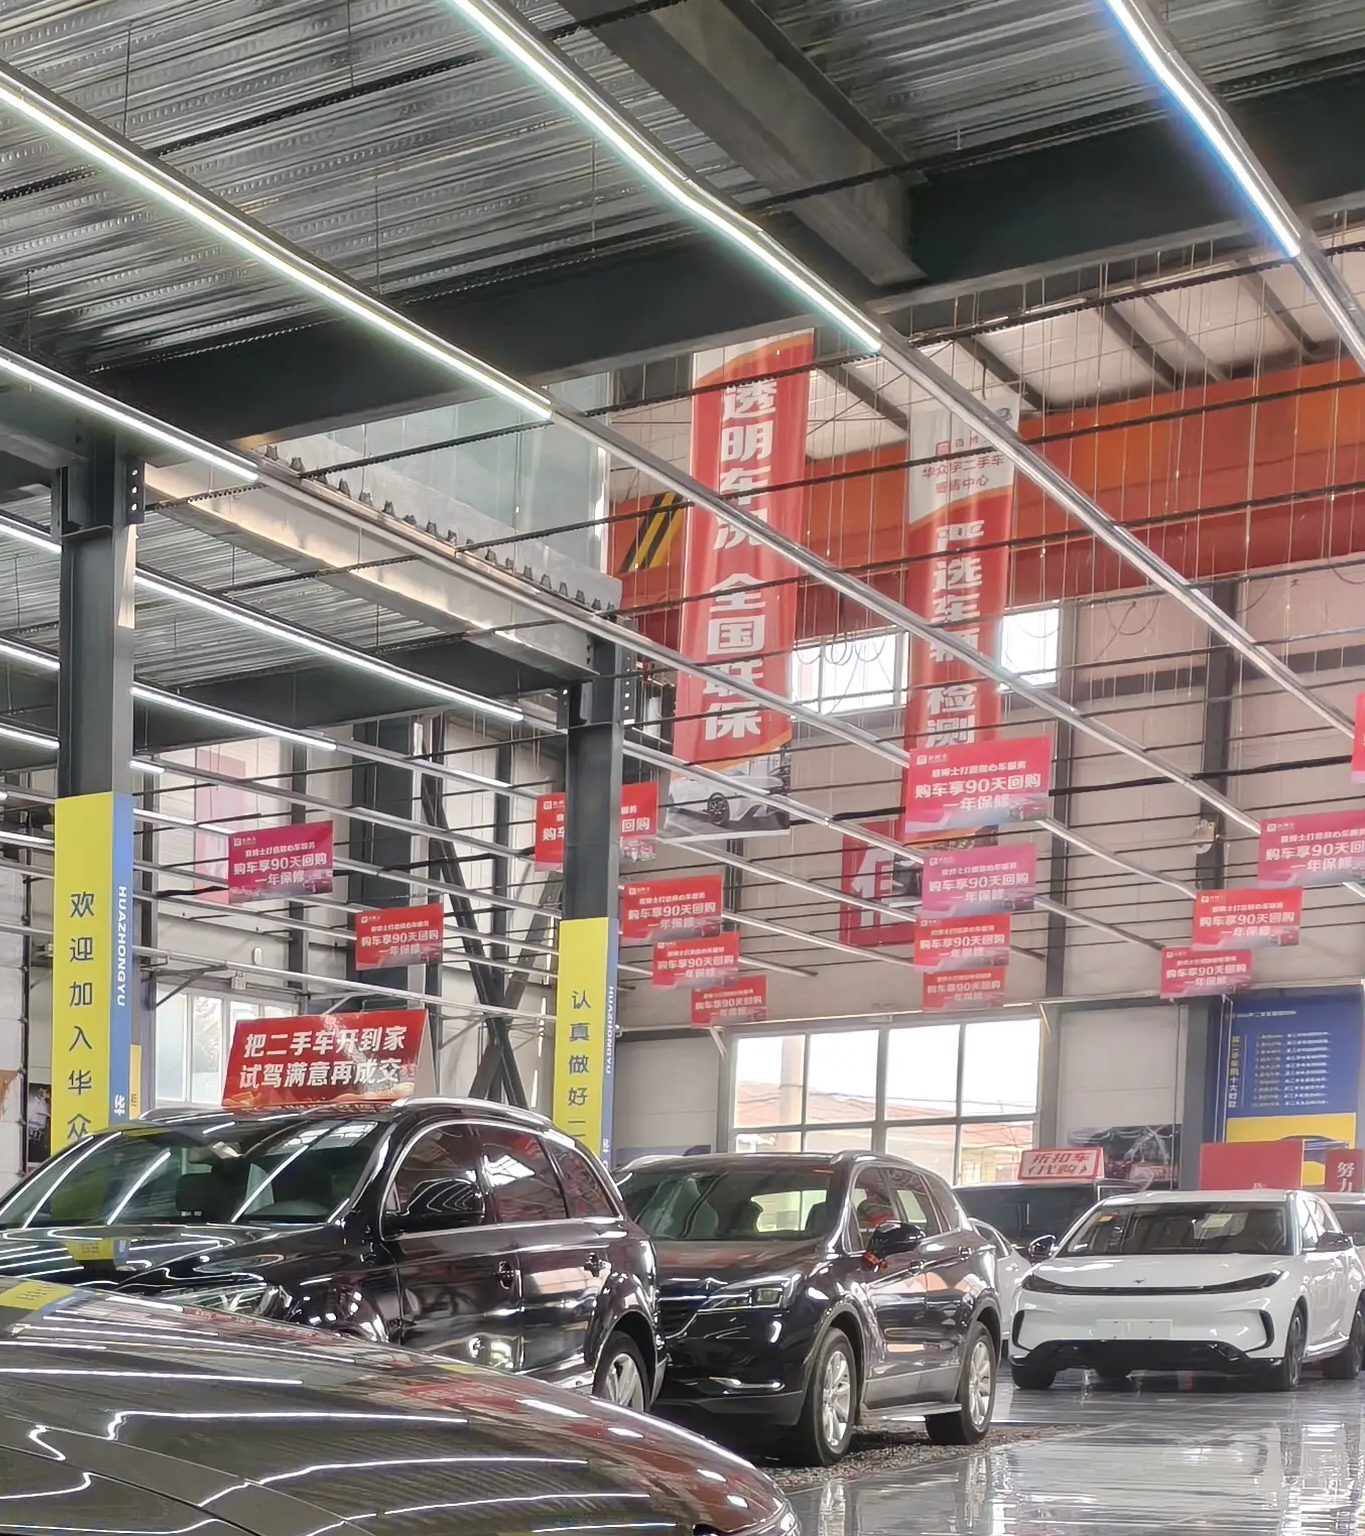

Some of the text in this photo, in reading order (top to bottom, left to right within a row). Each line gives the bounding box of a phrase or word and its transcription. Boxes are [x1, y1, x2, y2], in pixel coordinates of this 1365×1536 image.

[703, 572, 766, 741] 全国联保
[925, 684, 977, 748] 检测
[915, 773, 1041, 798] 购车享90天回购
[943, 794, 1012, 812] 一年保修
[233, 852, 328, 875] 购车享90天回购
[929, 872, 1029, 893] 购车享90天回购
[628, 902, 717, 920] 购车享90天回购
[1199, 912, 1295, 927] 购车享90天回购
[117, 886, 127, 1007] HUAZHONGYU
[361, 930, 439, 947] 购车享90天回购
[67, 890, 95, 1142] 欢迎加入华众
[243, 1025, 408, 1058] 把二手车开到家
[239, 1057, 402, 1089] 试驾满意再成交
[568, 990, 592, 1138] 认真做好二
[1032, 1152, 1093, 1163] 折扣车
